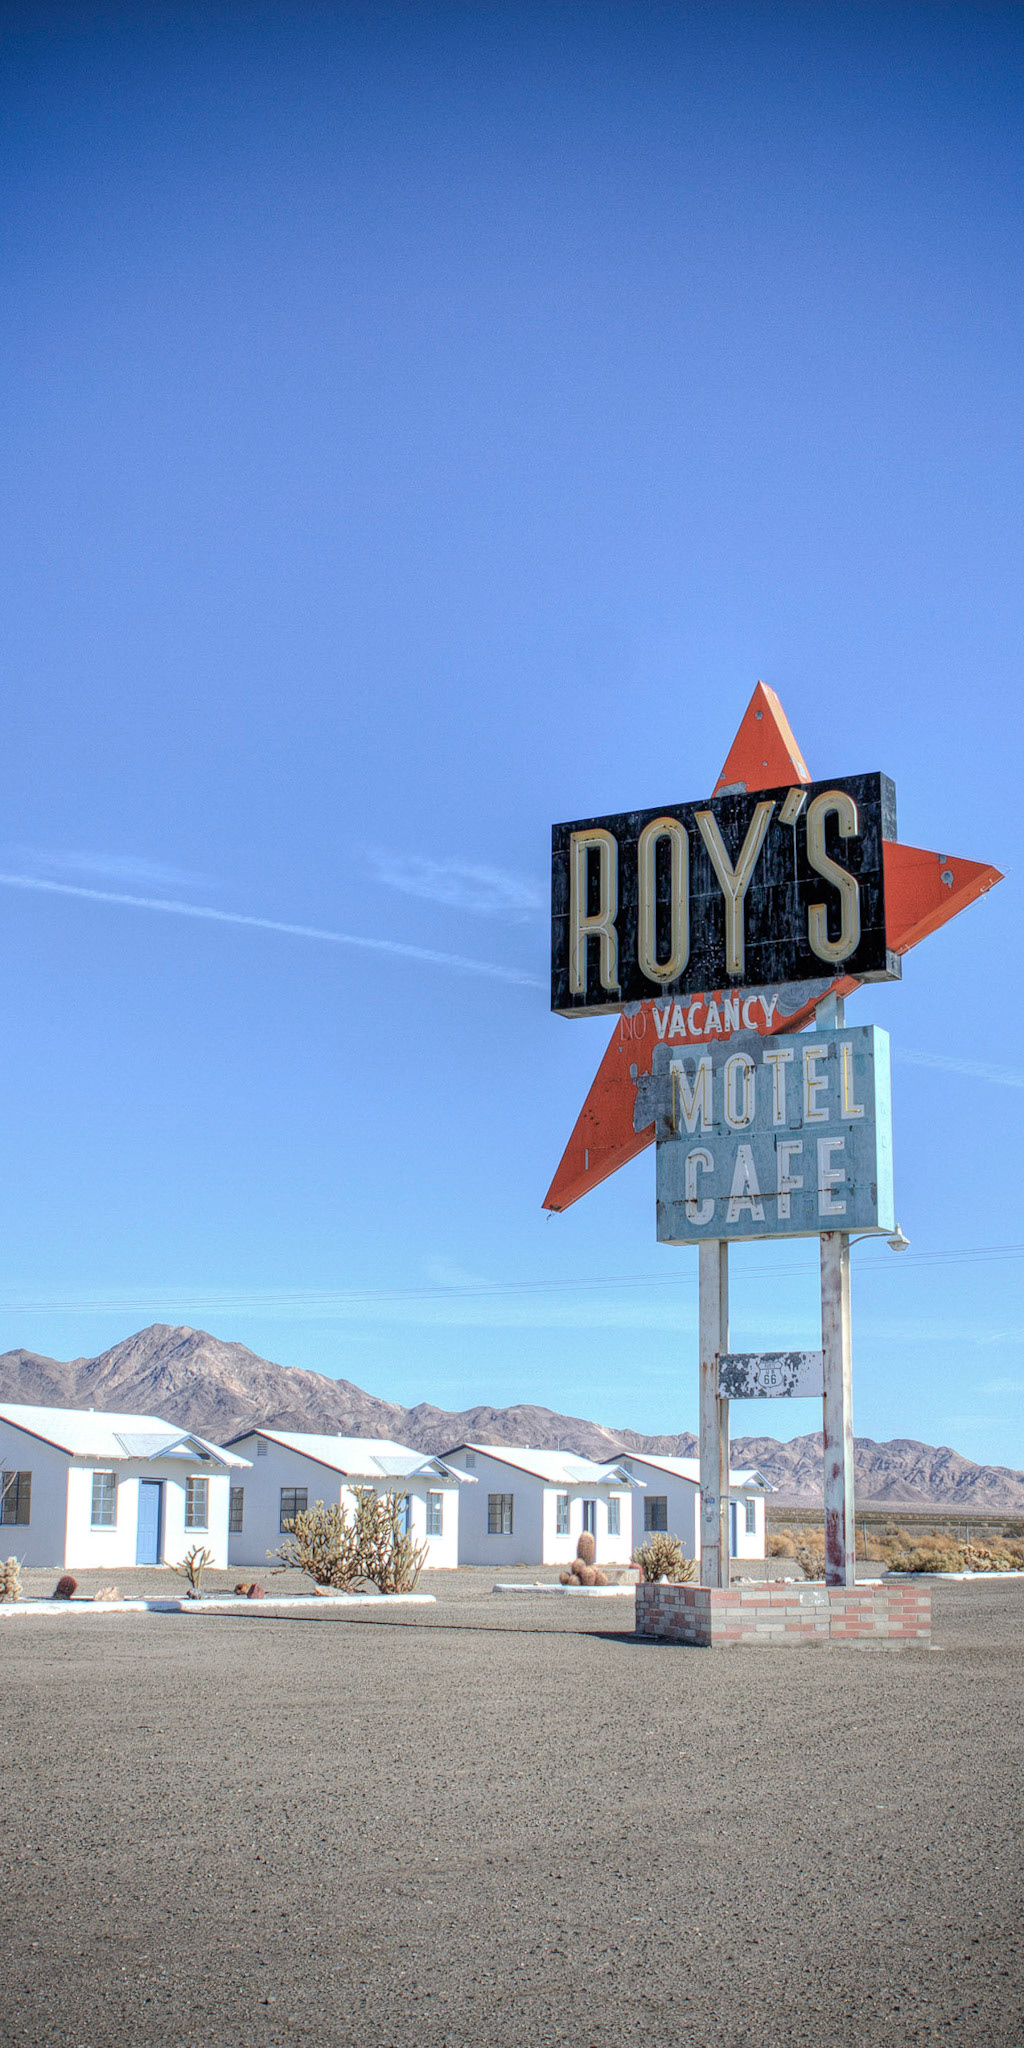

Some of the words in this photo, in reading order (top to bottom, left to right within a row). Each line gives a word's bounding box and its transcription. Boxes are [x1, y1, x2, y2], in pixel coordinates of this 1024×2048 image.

[569, 788, 860, 993] ROY'S
[620, 1009, 647, 1041] NO
[652, 993, 778, 1039] VACANCY
[670, 1042, 865, 1133] MOTEL
[685, 1137, 846, 1225] CAFE
[764, 1374, 777, 1385] 66
